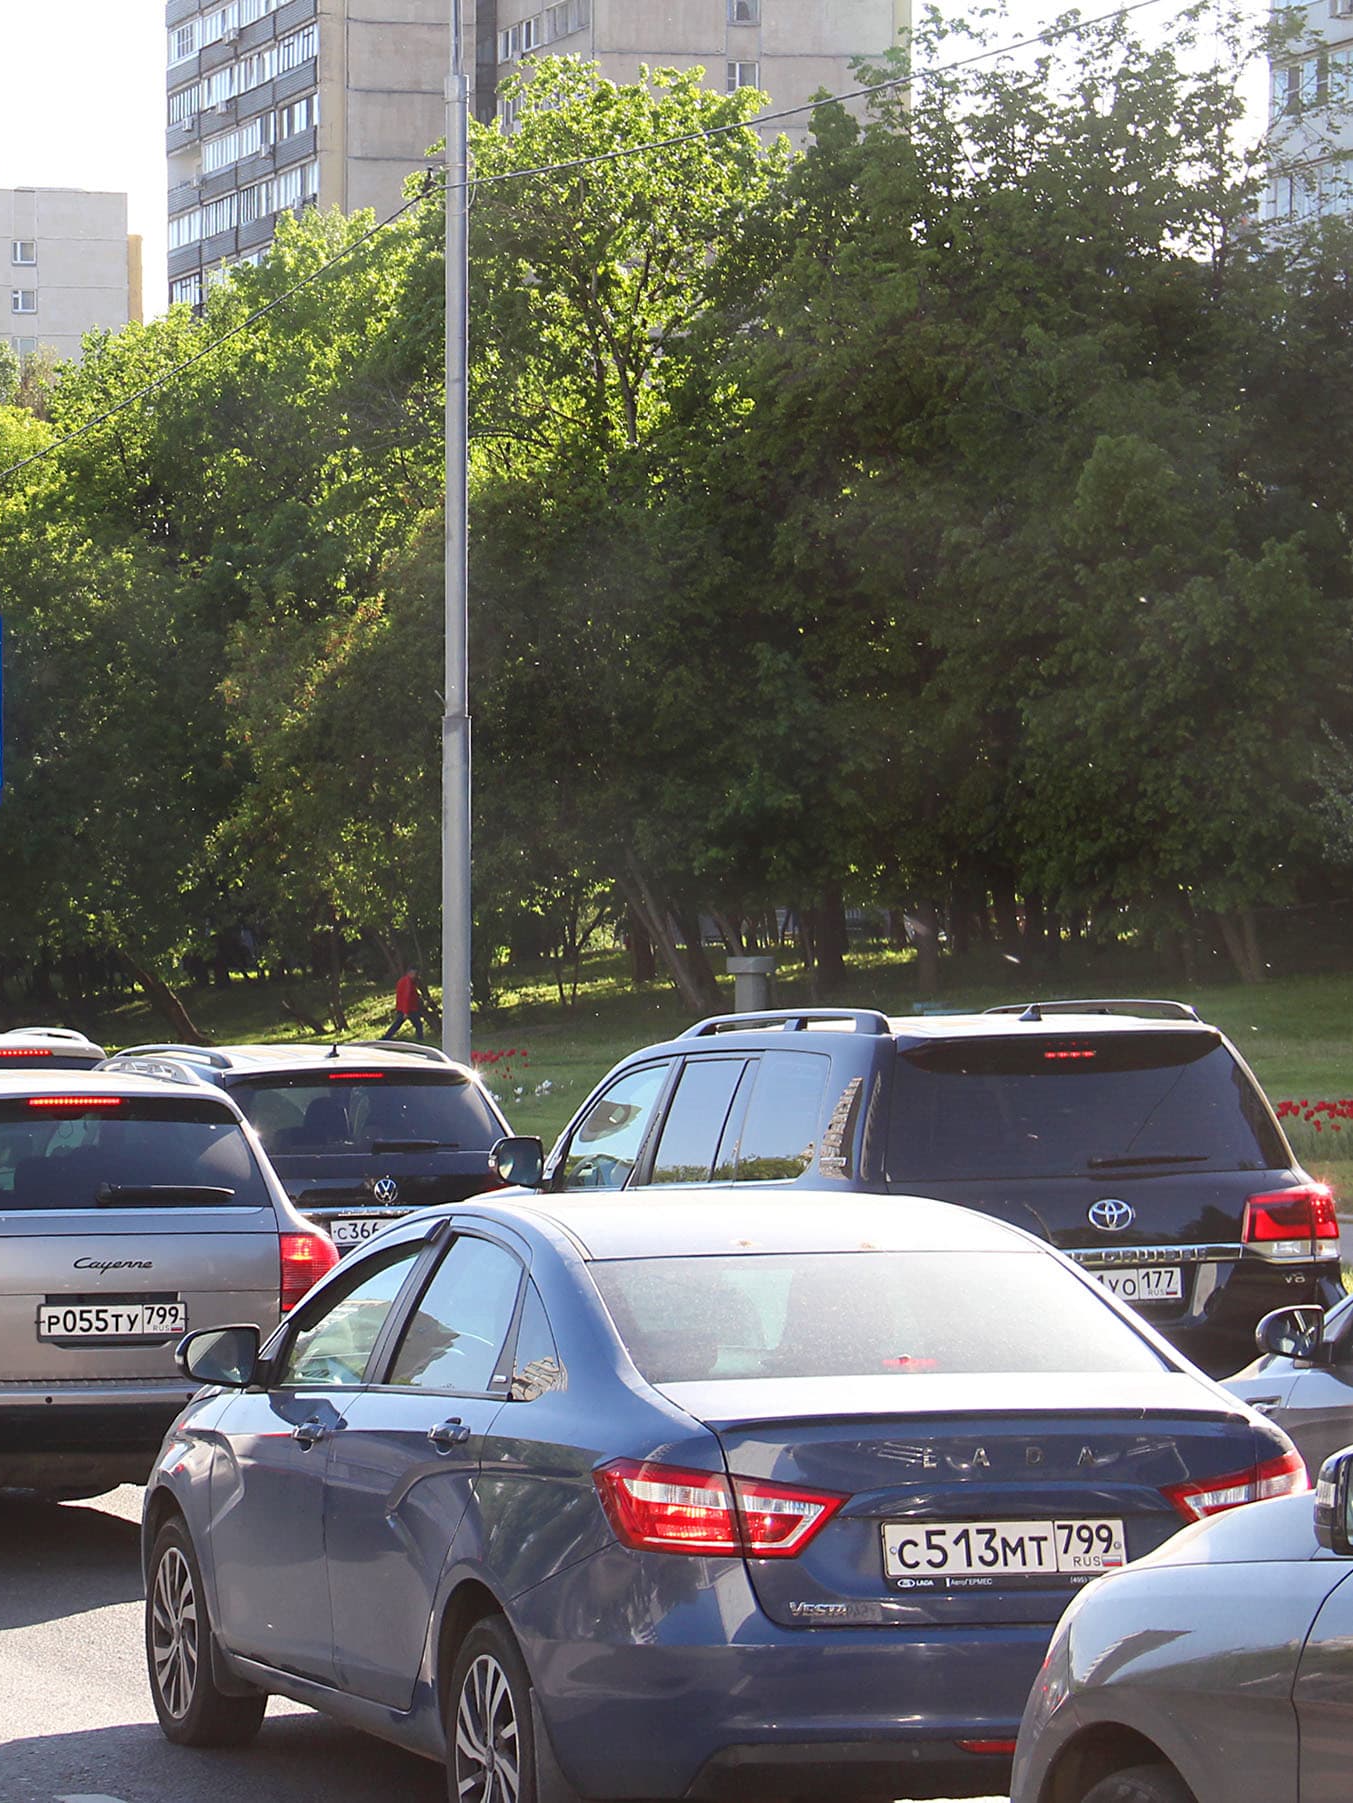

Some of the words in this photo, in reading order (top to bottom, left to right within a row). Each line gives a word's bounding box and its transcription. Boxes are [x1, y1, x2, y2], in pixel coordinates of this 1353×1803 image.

[337, 1222, 380, 1240] С366
[73, 1257, 153, 1275] Cayenne
[1141, 1270, 1174, 1289] 177
[145, 1306, 179, 1325] 799
[1056, 1524, 1113, 1554] 799
[1072, 1556, 1101, 1567] RUS
[789, 1601, 849, 1618] VESTA
